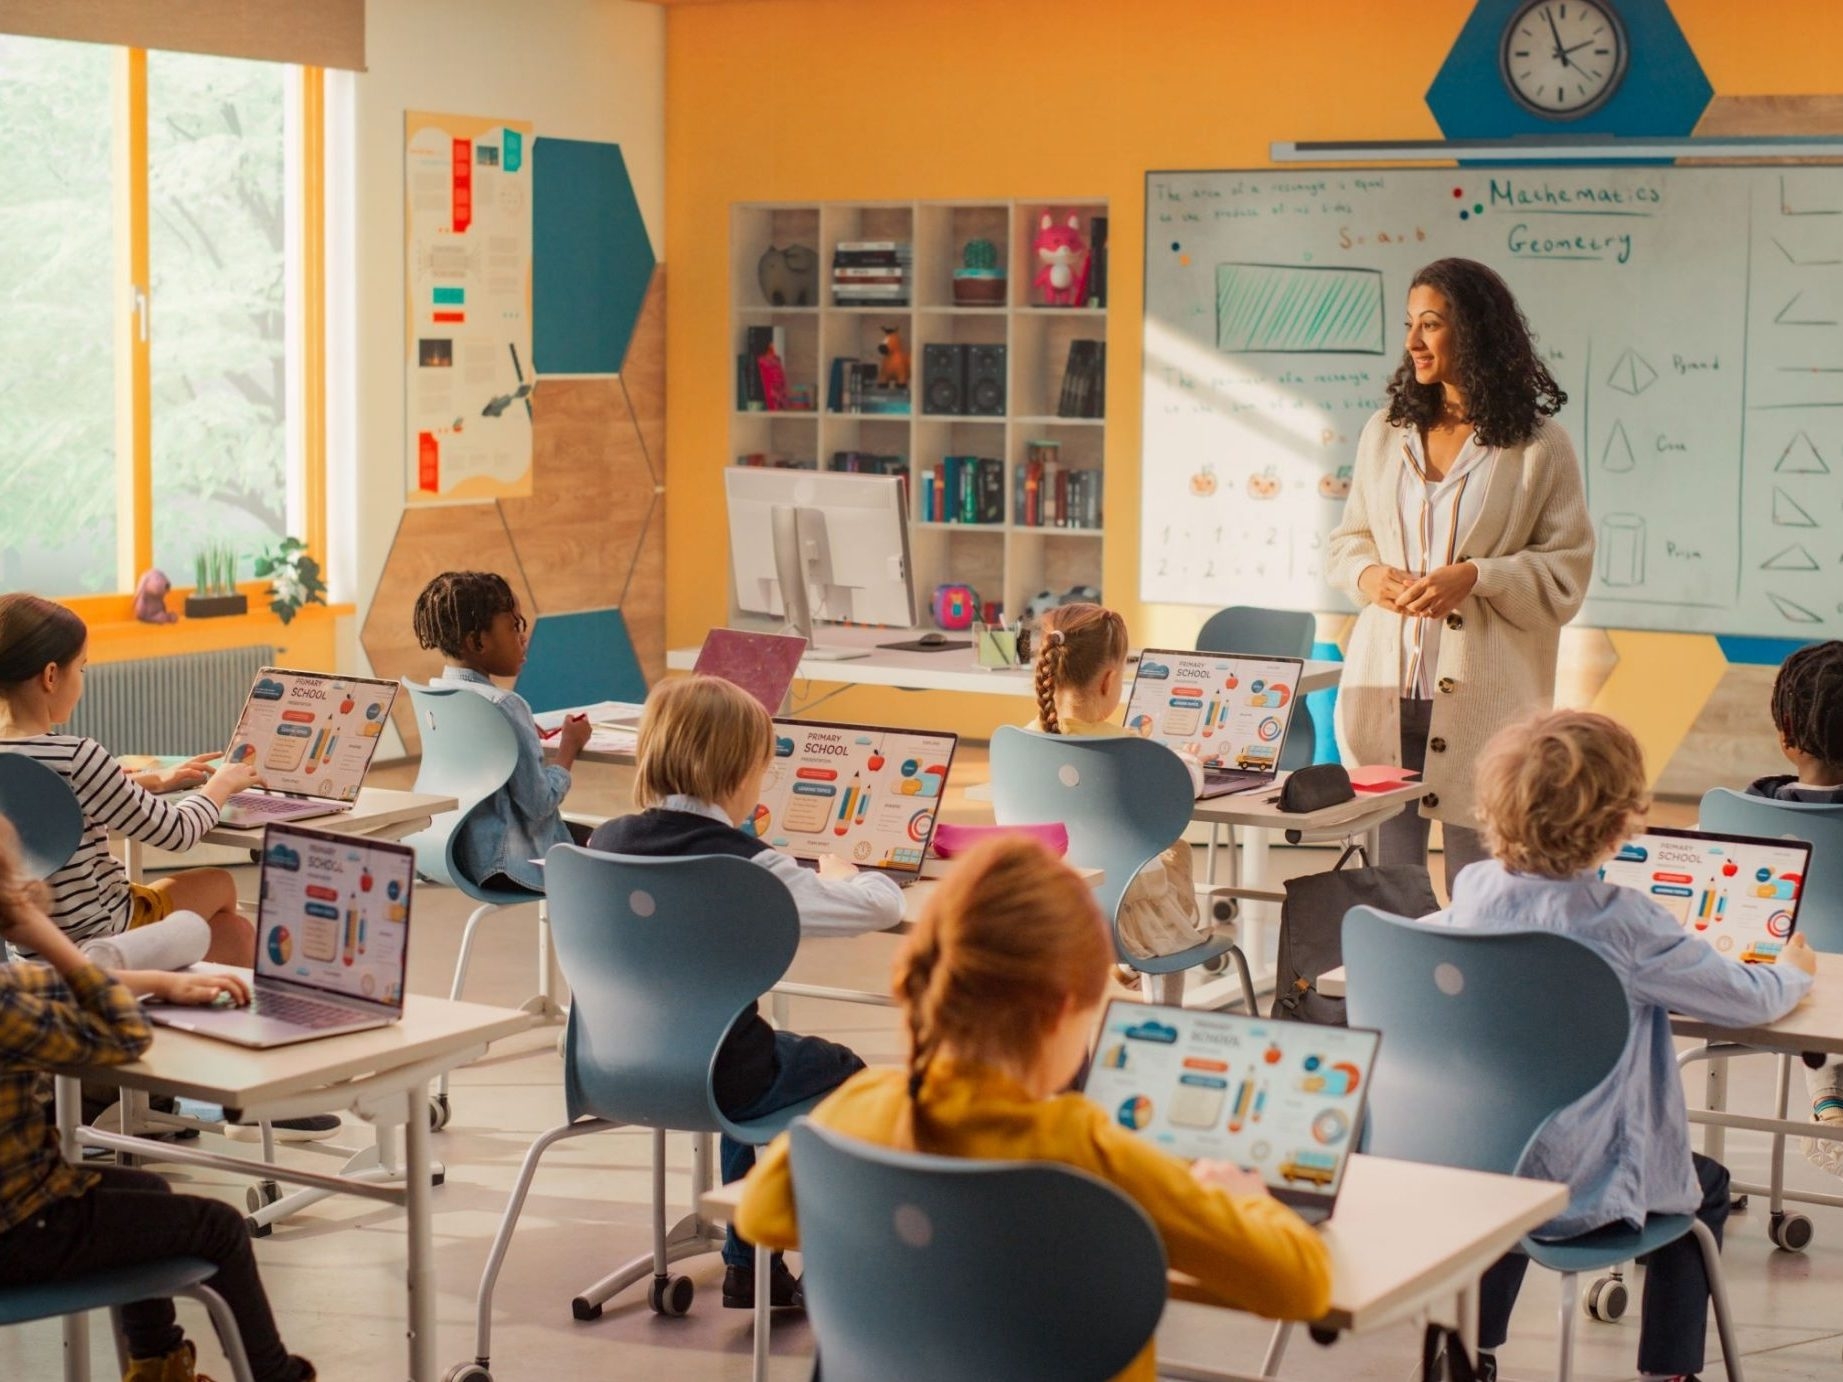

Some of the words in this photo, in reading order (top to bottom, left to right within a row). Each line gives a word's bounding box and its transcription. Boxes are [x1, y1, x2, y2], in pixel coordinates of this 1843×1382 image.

[1490, 179, 1660, 206] Mathematics
[1508, 224, 1631, 264] Geometry
[1176, 668, 1212, 679] SCHOOL
[291, 687, 328, 701] SCHOOL
[807, 732, 843, 742] PRIMARY
[803, 742, 849, 757] SCHOOL
[1658, 850, 1704, 865] SCHOOL
